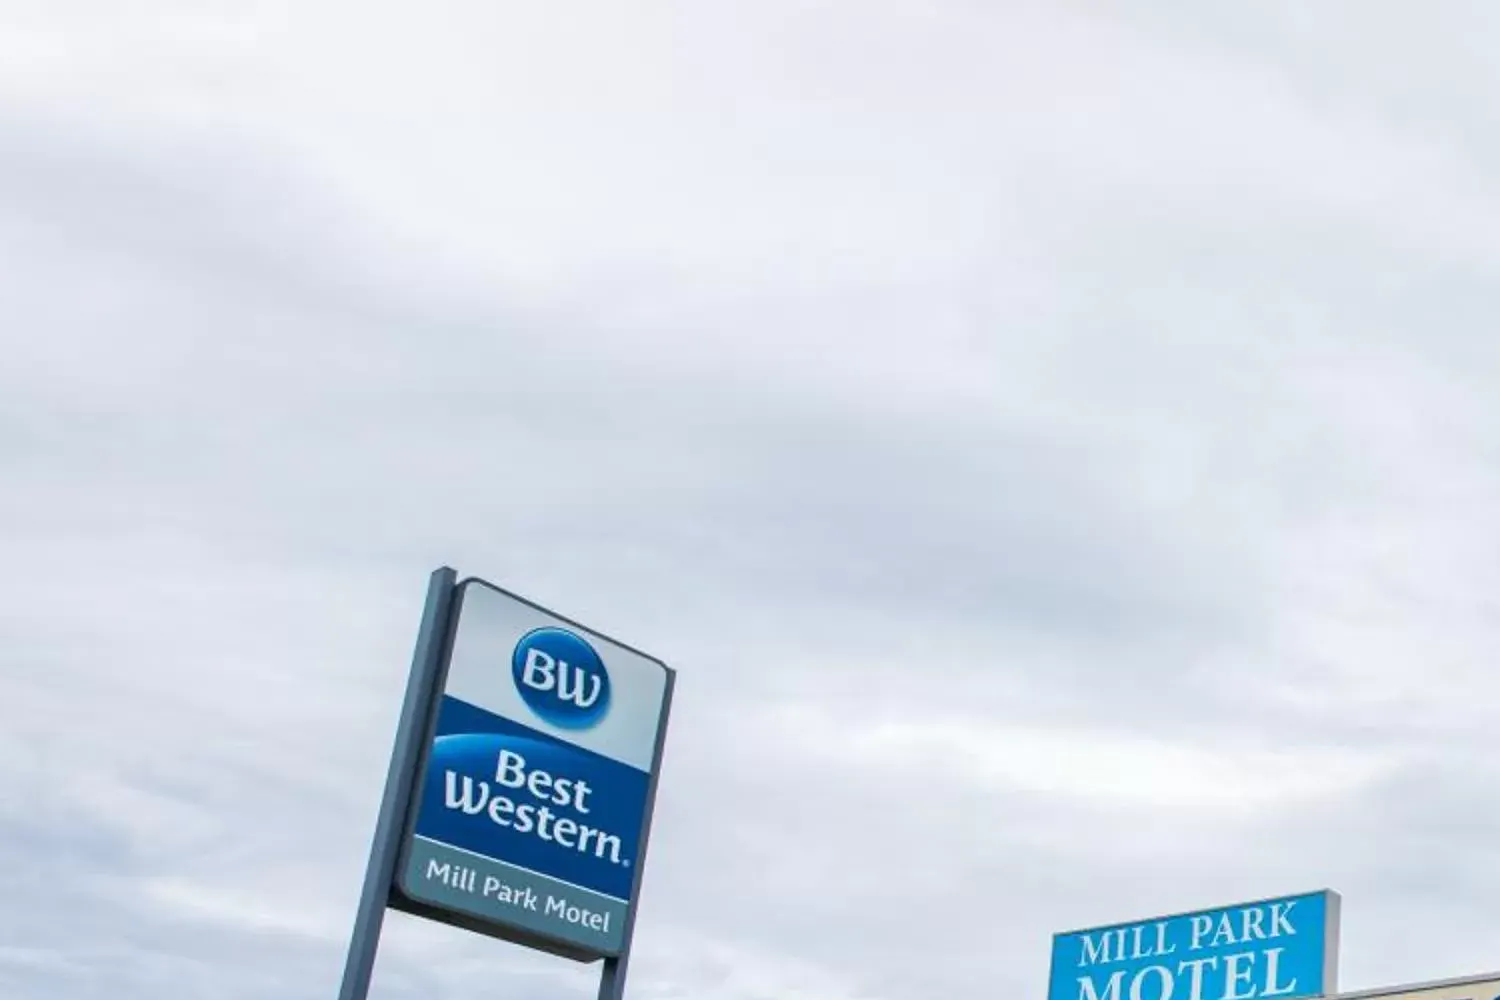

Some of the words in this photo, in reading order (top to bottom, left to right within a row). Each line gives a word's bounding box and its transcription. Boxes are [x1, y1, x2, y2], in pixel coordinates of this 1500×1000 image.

[522, 647, 602, 709] BW
[495, 749, 593, 814] Best
[425, 858, 477, 893] Mill
[483, 875, 538, 911] Park
[544, 894, 612, 933] Motel
[1077, 921, 1177, 968] MILL
[1188, 901, 1298, 952] PARK
